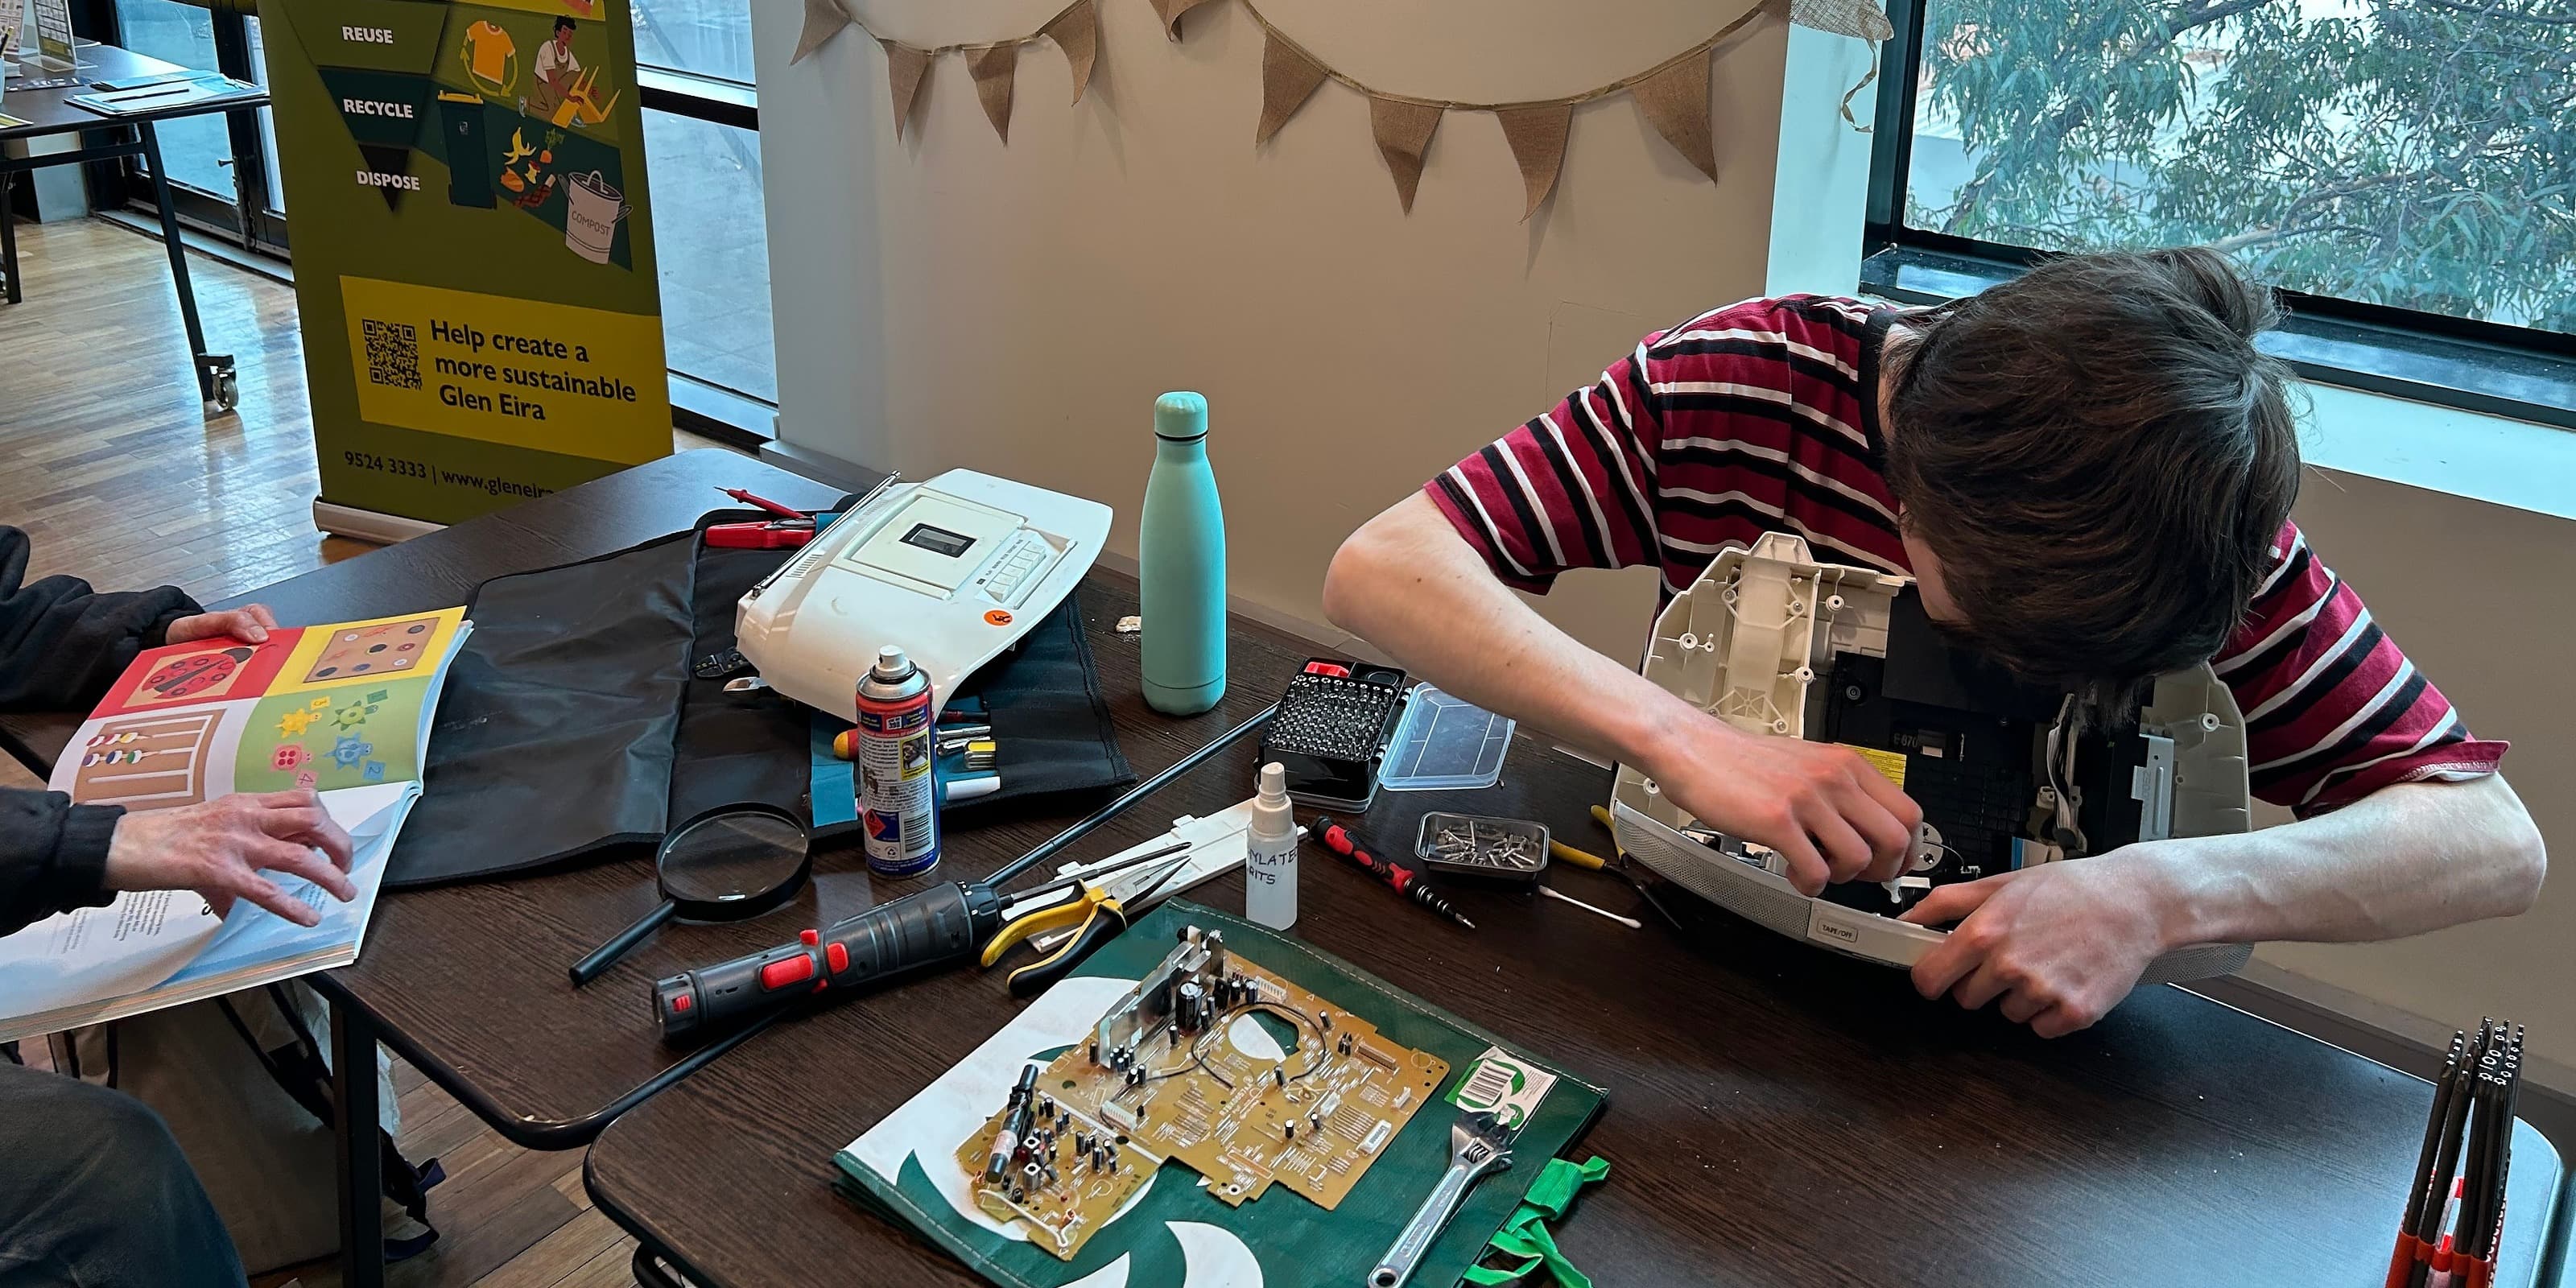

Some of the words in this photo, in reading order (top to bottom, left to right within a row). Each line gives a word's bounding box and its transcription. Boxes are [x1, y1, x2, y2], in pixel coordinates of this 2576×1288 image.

[342, 26, 394, 44] REUSE
[343, 98, 414, 118] RECYCLE
[356, 170, 420, 191] DISPOSE
[572, 211, 610, 236] COMPOST
[430, 319, 485, 353] Help
[493, 333, 568, 360] create
[575, 345, 590, 363] a
[436, 357, 497, 382] more
[502, 366, 637, 402] sustainable
[440, 384, 493, 413] Glen
[498, 392, 547, 421] Eira
[345, 451, 384, 471] 9524
[389, 458, 427, 479] 3333
[299, 773, 313, 784] 4
[367, 766, 382, 776] 2
[1822, 924, 1853, 939] TAPE/OFF
